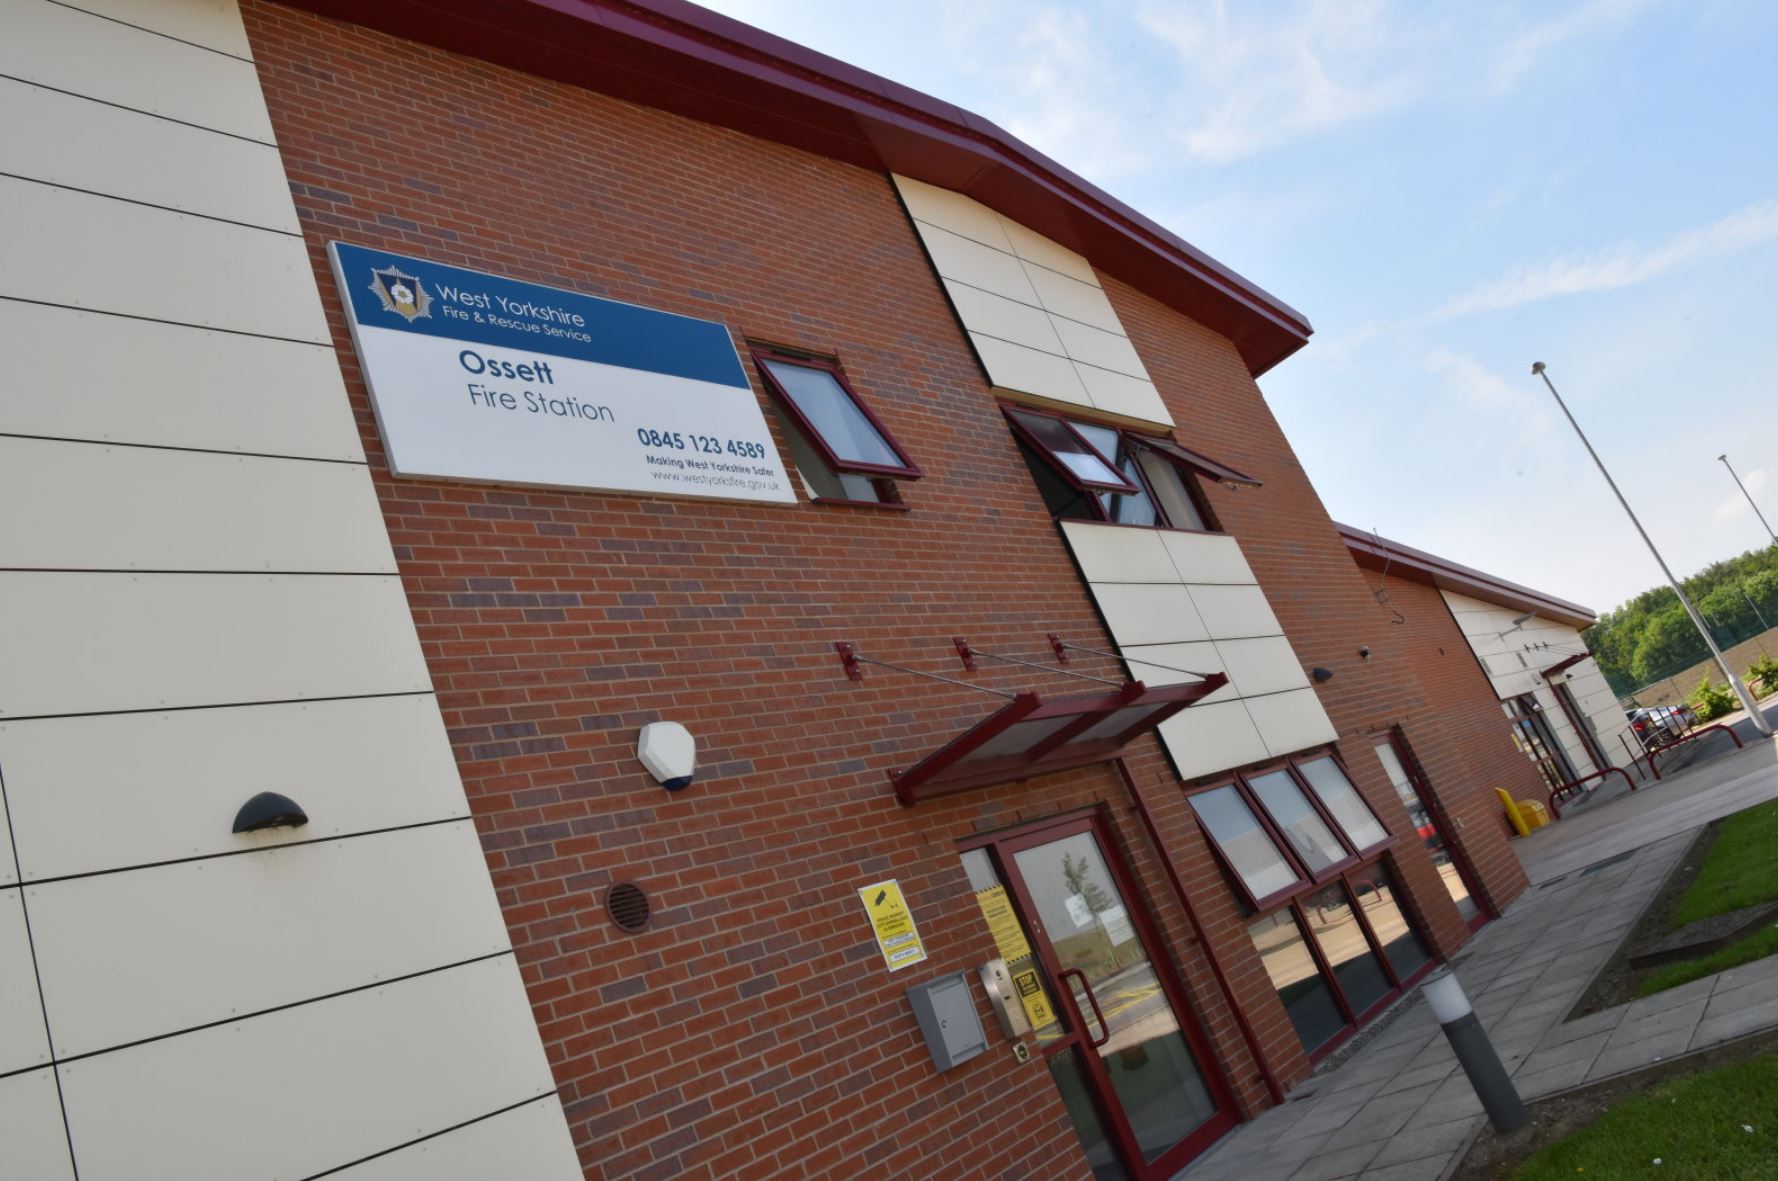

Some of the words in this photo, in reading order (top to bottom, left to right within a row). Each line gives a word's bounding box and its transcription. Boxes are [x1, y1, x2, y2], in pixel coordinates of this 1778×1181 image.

[435, 283, 491, 309] West
[495, 295, 585, 328] Yorkshire
[442, 305, 469, 321] Fire
[474, 312, 486, 324] &
[488, 314, 540, 333] Rescue
[543, 323, 592, 343] Service
[459, 350, 554, 385] Ossett
[467, 383, 517, 410] Fire
[524, 391, 615, 423] Station
[637, 428, 685, 450] 0845
[689, 435, 722, 455] 123
[727, 439, 765, 459] 4589
[646, 455, 684, 469] Making
[686, 459, 709, 470] West
[711, 462, 751, 474] Yorkshire
[752, 466, 774, 477] Safer
[652, 471, 780, 491] www.westyorksfire.gov.uk
[1018, 974, 1034, 986] STOP
